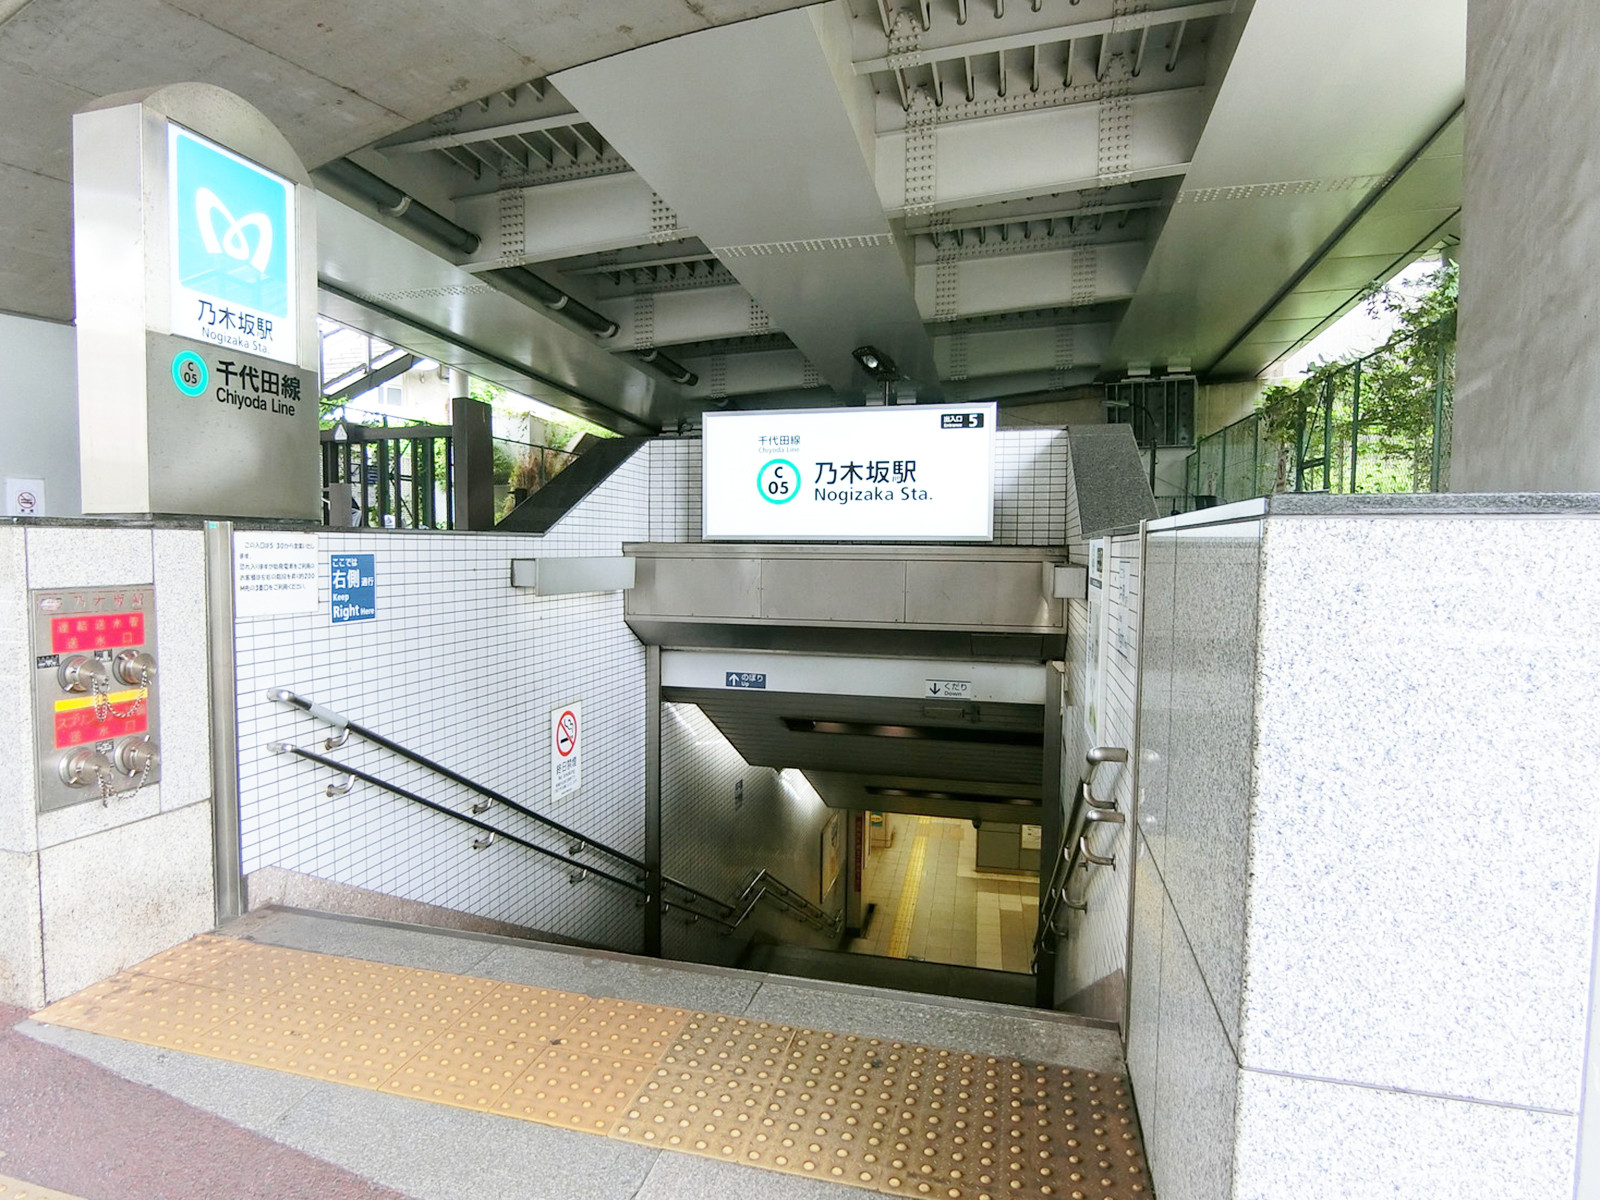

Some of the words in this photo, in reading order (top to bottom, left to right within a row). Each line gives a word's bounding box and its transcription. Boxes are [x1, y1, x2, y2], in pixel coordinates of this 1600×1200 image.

[198, 299, 273, 341] 乃木坂駅
[202, 326, 250, 348] Nogizaka
[252, 340, 270, 354] Sta.
[187, 362, 194, 372] C
[183, 372, 198, 384] 05
[216, 360, 301, 401] 千代田線
[216, 387, 267, 410] Chiyoda
[271, 398, 296, 416] Line
[968, 414, 979, 428] 5
[758, 435, 801, 446] 千代田線
[758, 446, 785, 455] Chiyoda
[774, 466, 783, 479] C
[814, 460, 917, 485] 乃木坂駅
[768, 481, 789, 495] 05
[814, 487, 894, 505] Nogizaka
[901, 486, 933, 501] Sta.
[332, 558, 358, 567] ここでは
[333, 593, 350, 602] Keep
[333, 604, 360, 620] Right
[360, 607, 375, 616] Here
[740, 673, 763, 682] のぼり
[944, 682, 967, 691] くだり
